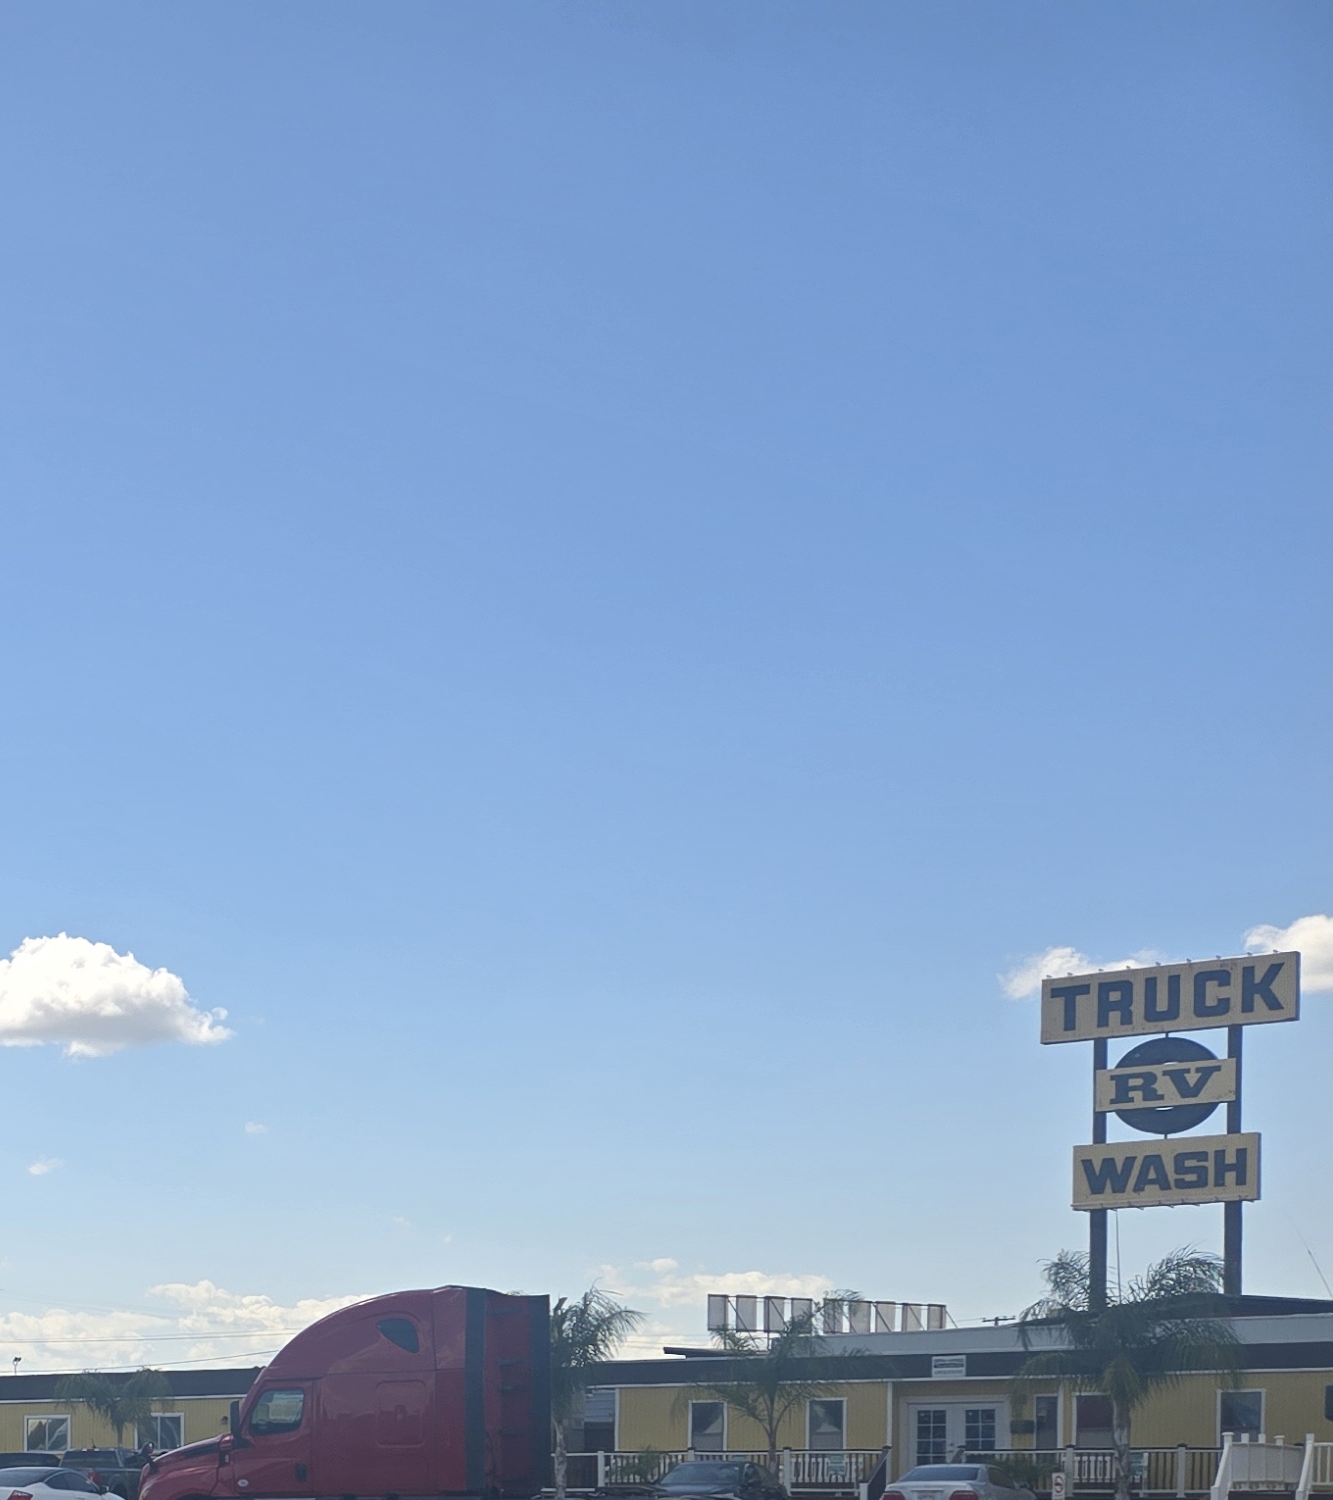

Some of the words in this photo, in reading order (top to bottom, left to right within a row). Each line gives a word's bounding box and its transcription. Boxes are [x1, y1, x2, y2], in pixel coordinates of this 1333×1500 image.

[1050, 962, 1285, 1032] TRUCK
[1109, 1065, 1222, 1105] RV
[1081, 1147, 1248, 1195] WASH
